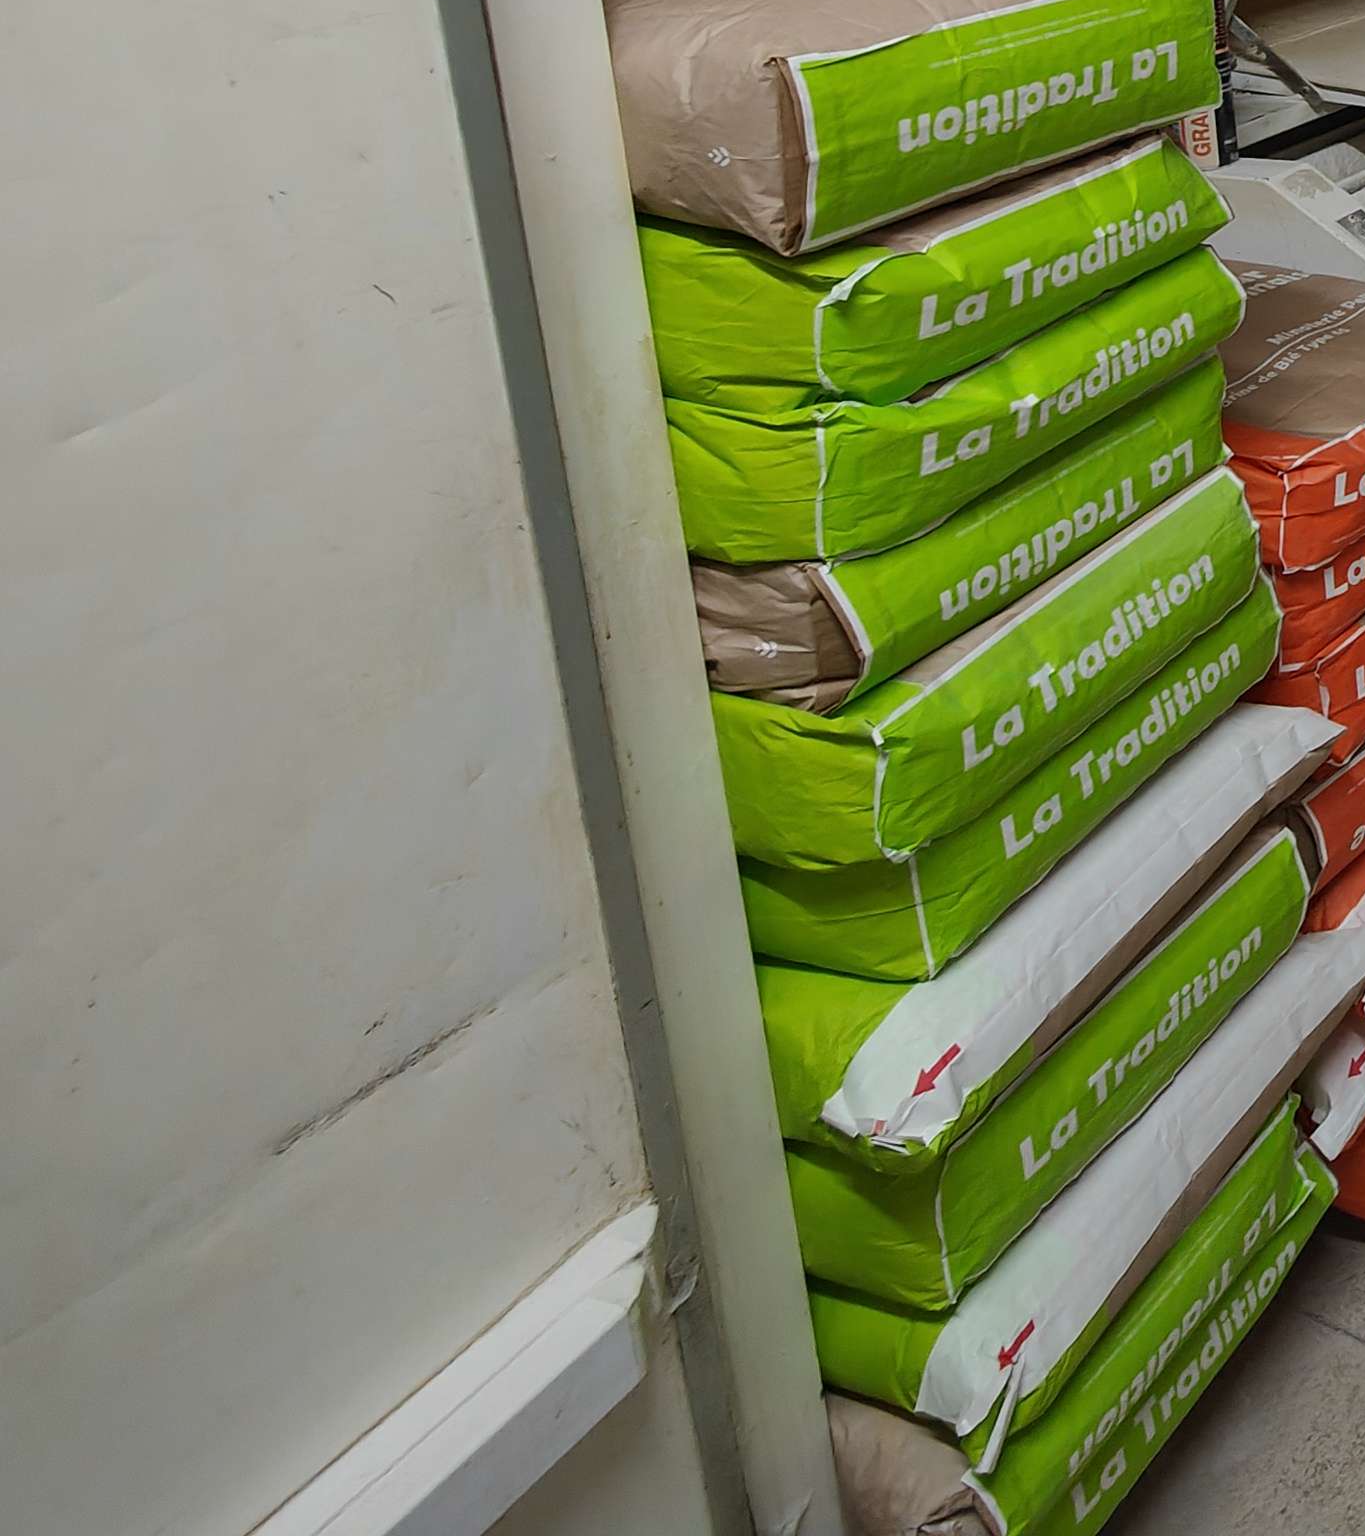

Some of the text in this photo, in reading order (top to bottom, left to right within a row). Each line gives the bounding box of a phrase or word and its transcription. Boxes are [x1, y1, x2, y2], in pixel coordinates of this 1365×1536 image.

[897, 59, 1120, 153] Tradition
[1131, 39, 1178, 84] La
[918, 197, 1188, 341] La Tradition
[920, 311, 1194, 477] La Tradition
[1223, 383, 1259, 409] arine
[1273, 351, 1301, 370] Blé
[939, 439, 1194, 621] La Tradition
[960, 552, 1213, 772] La Tradition
[999, 643, 1241, 860] La Tradition
[1018, 925, 1263, 1181] La Tradition
[1071, 1240, 1296, 1524] La Tradition
